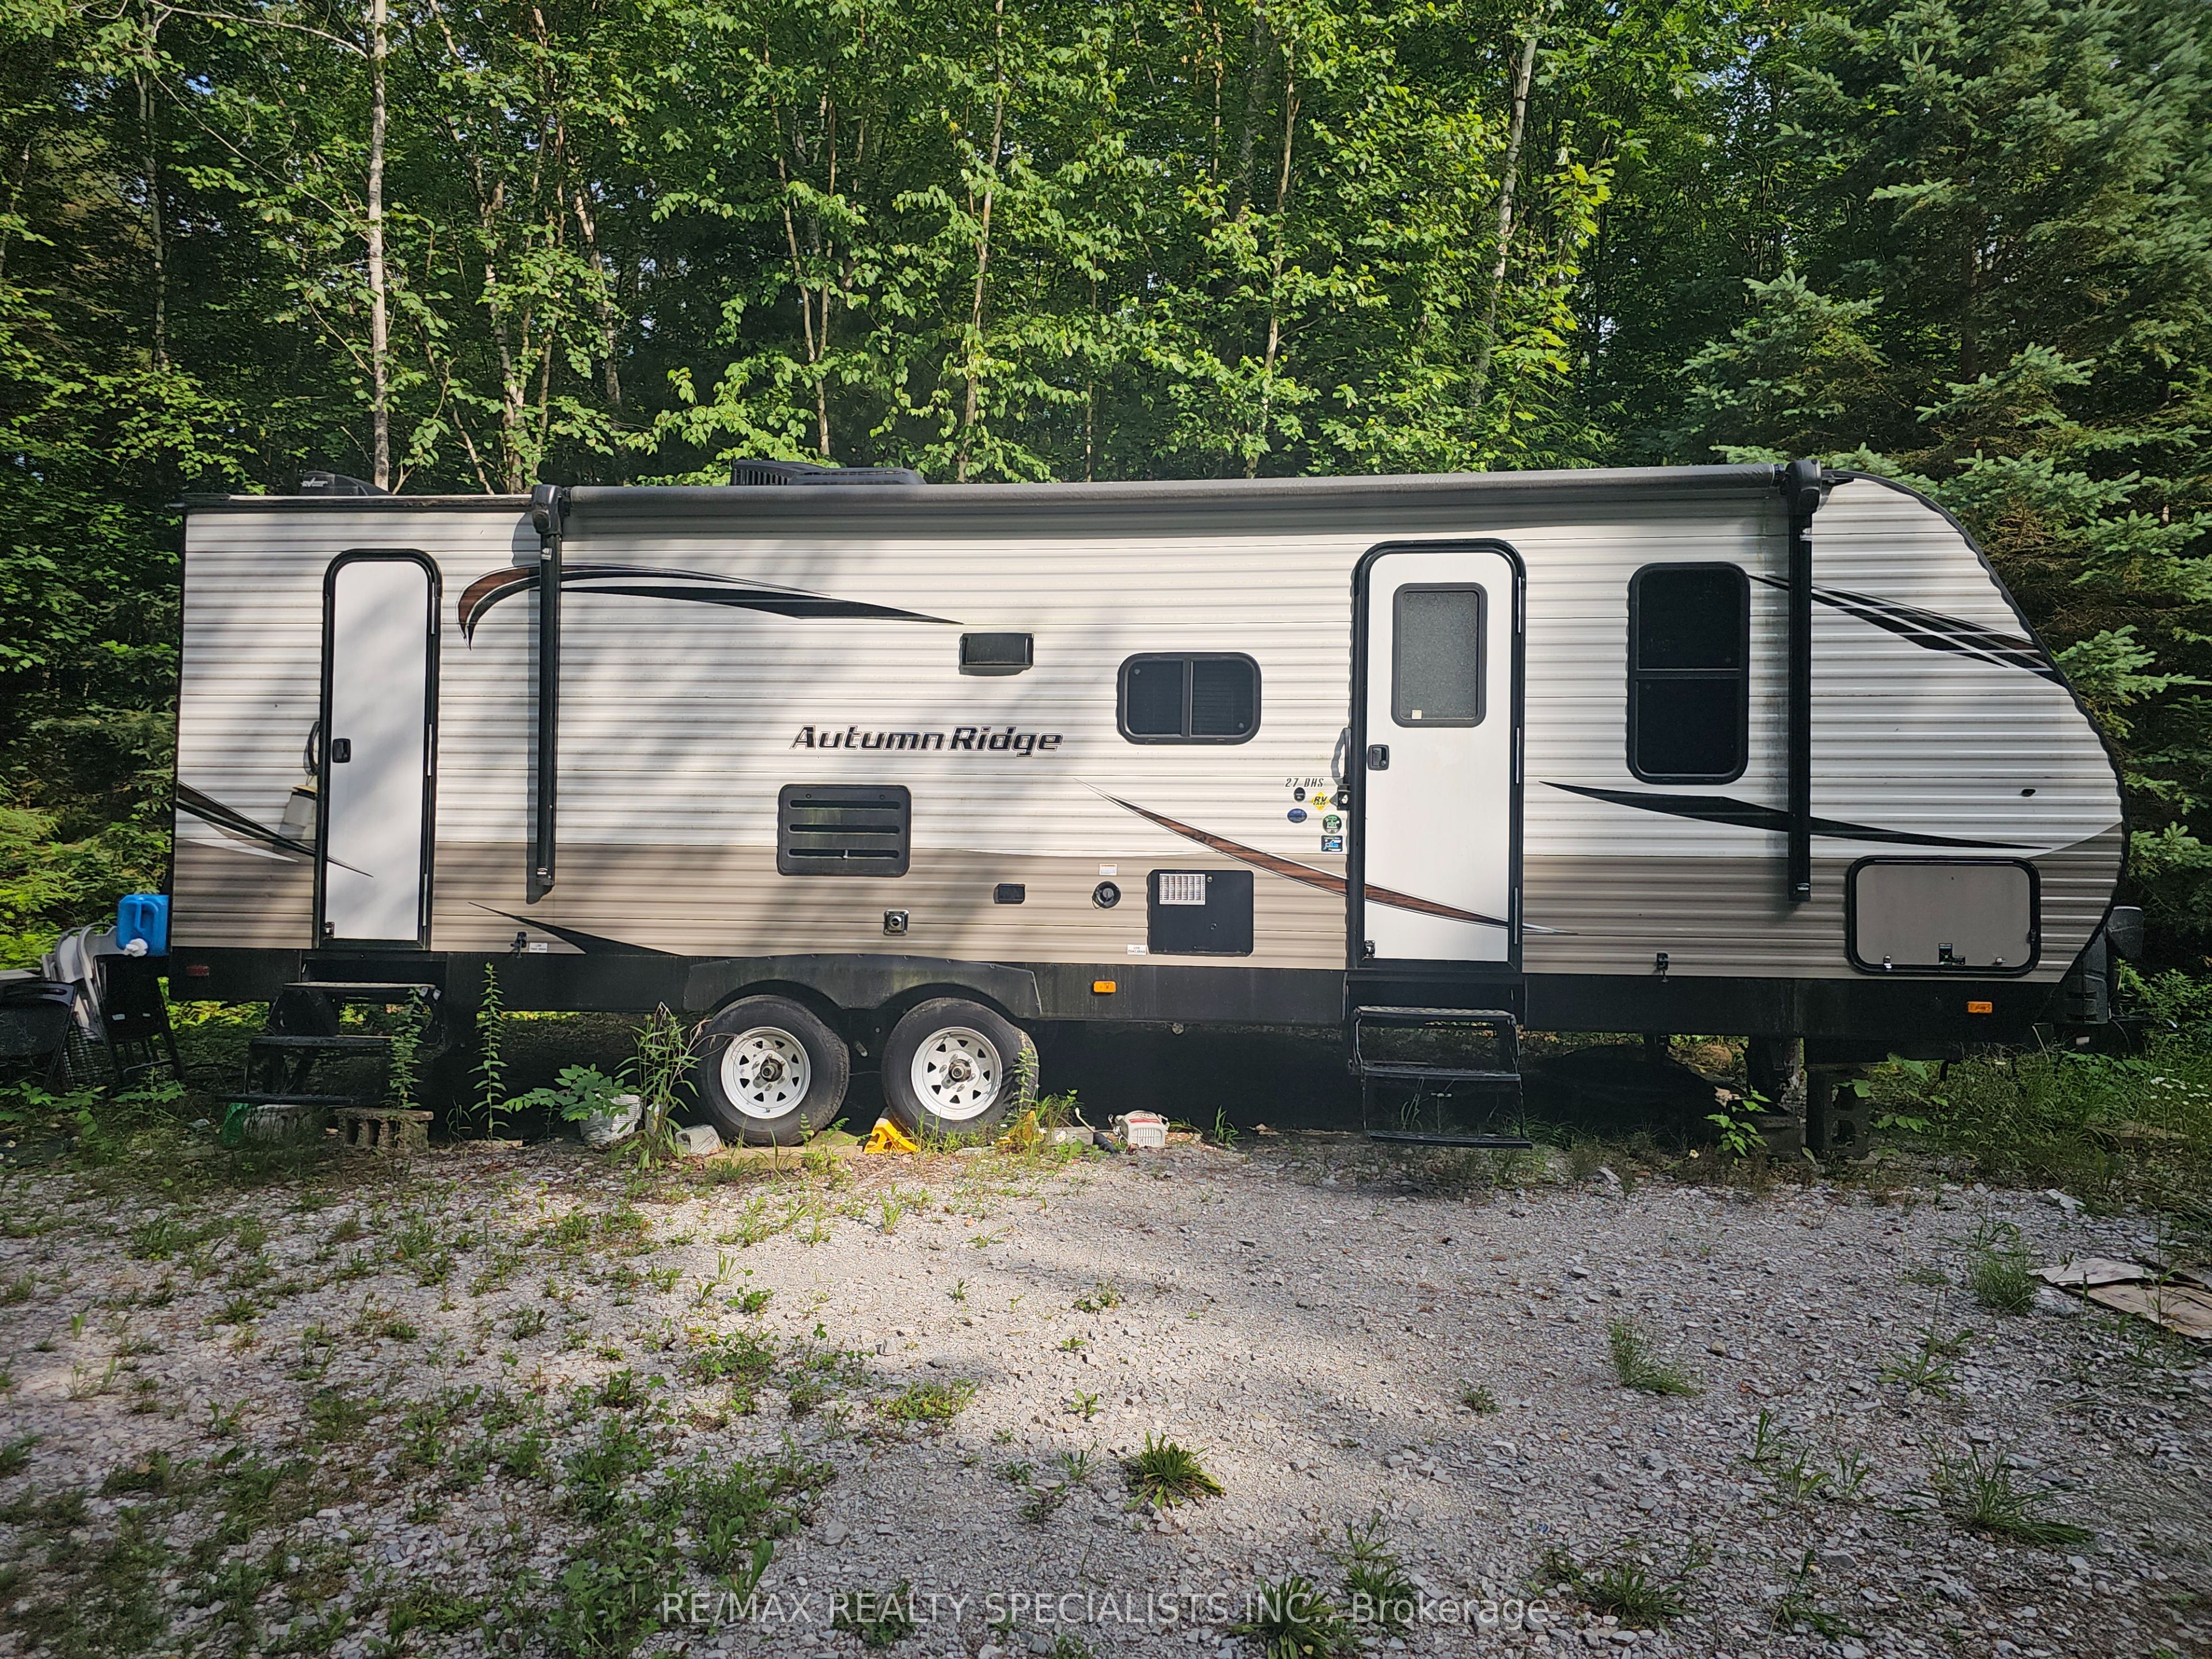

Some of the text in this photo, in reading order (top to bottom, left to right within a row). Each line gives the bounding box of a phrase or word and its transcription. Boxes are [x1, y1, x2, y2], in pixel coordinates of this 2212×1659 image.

[789, 725, 1063, 757] Autumn Ridge
[1285, 778, 1324, 787] 27 BHS
